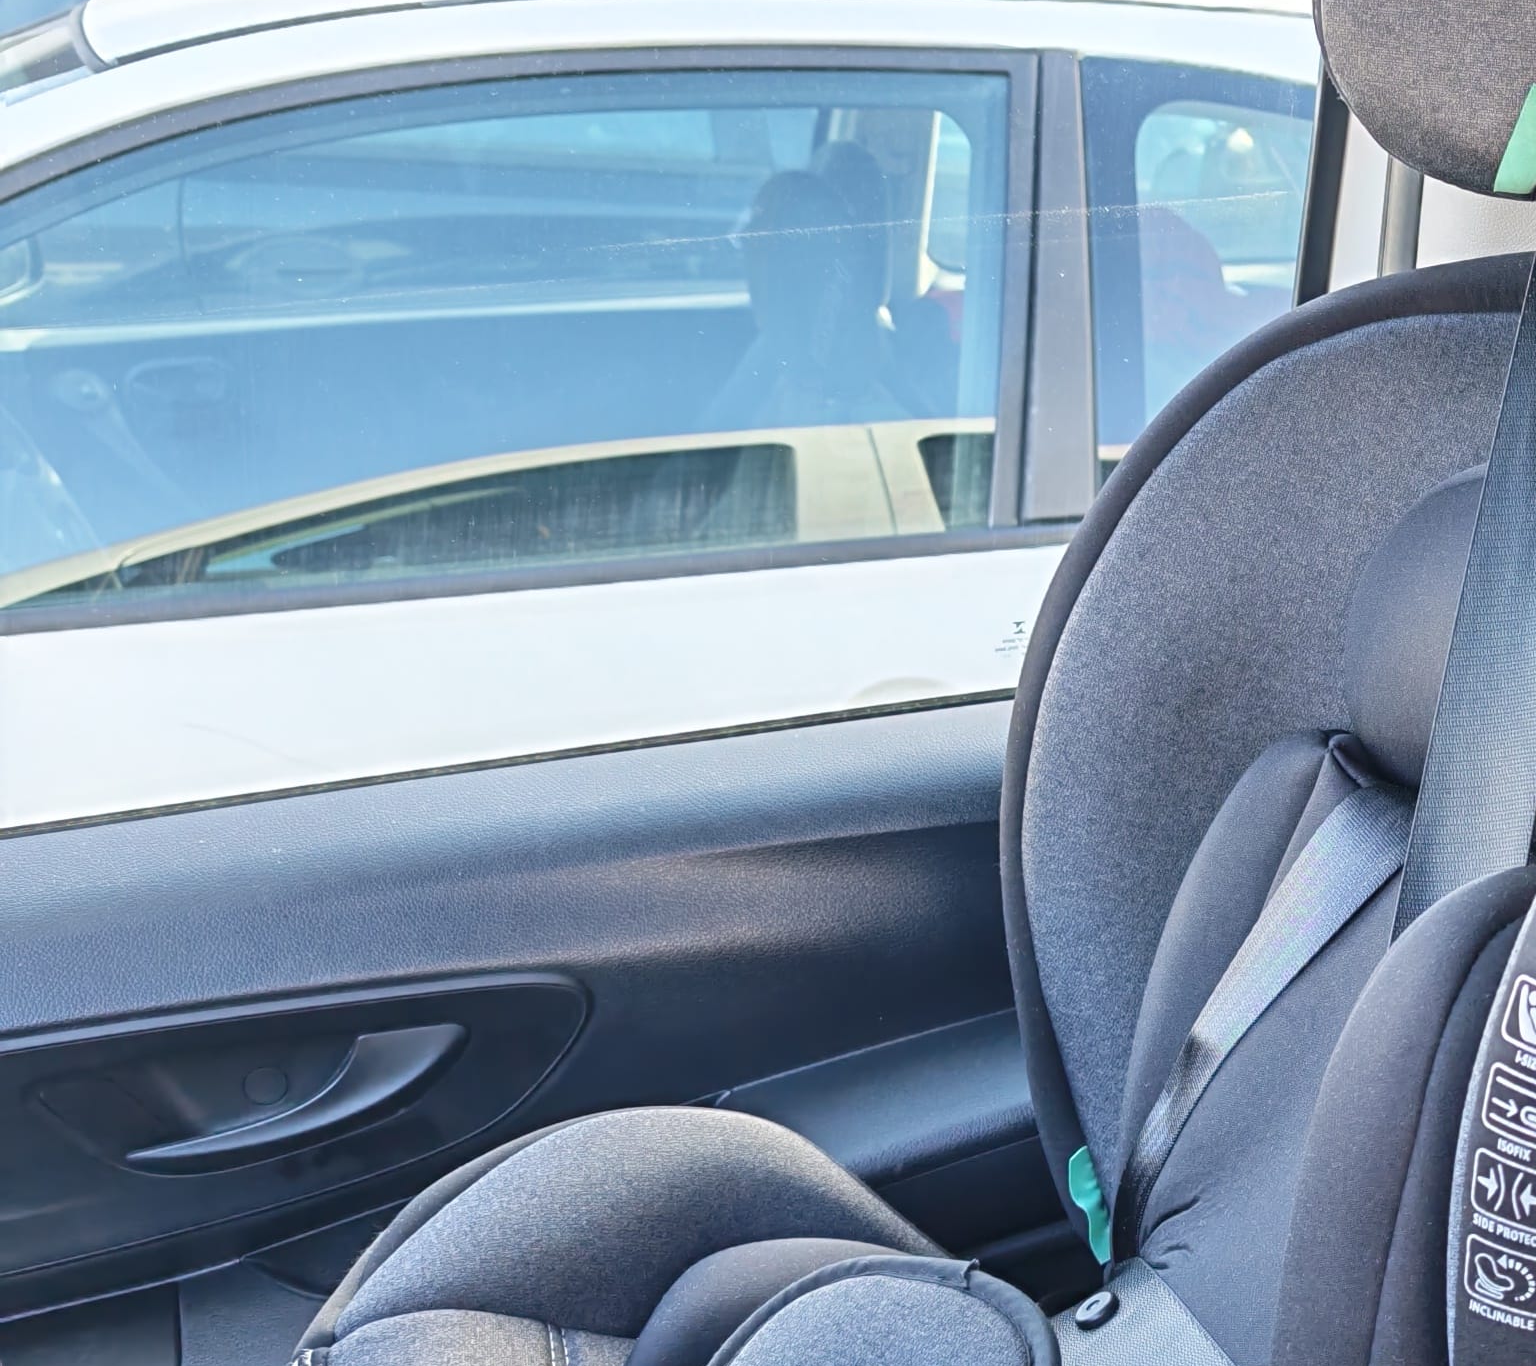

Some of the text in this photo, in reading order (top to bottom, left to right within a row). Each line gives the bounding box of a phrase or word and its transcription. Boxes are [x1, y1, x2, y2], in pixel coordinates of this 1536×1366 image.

[1497, 1138, 1532, 1162] ISOFIX
[1472, 1213, 1495, 1233] SIDE
[1469, 1298, 1535, 1331] INCLINABLE
